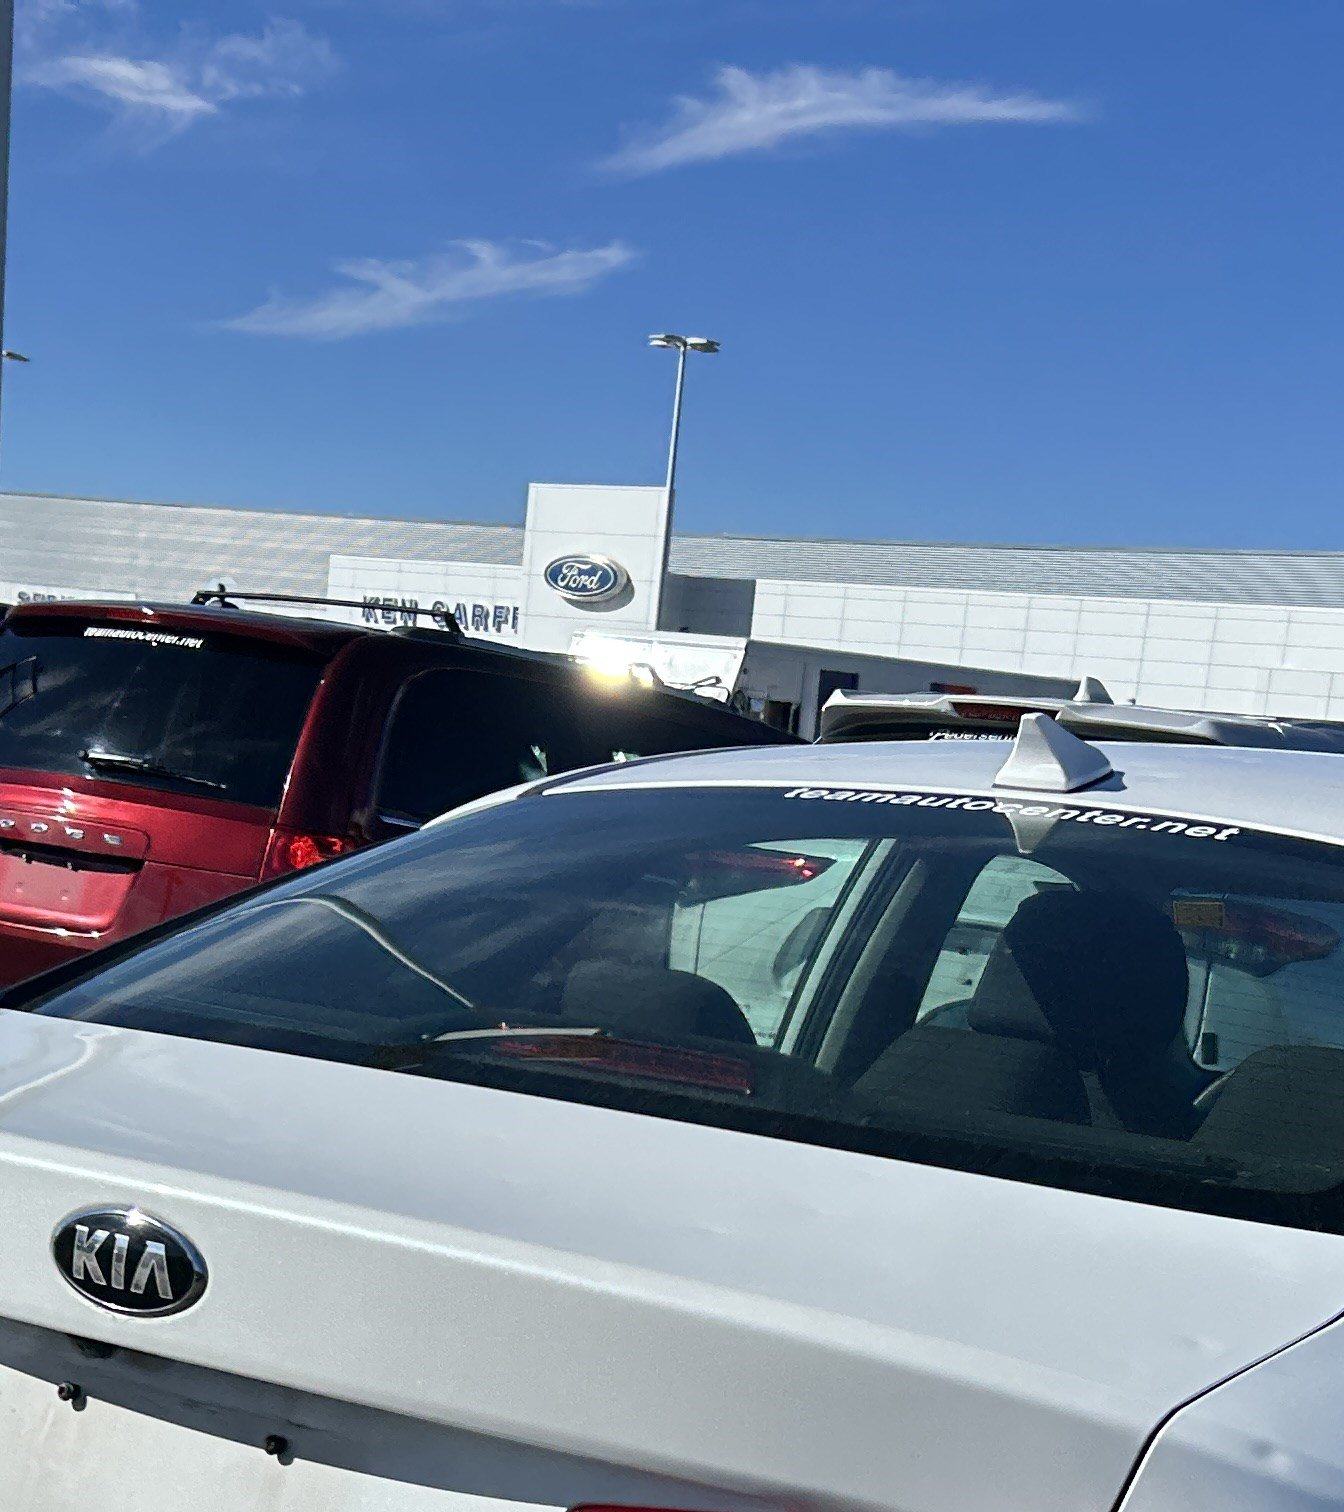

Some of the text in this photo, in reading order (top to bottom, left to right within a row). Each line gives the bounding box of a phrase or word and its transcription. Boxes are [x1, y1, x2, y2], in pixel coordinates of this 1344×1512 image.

[557, 562, 603, 590] Ford
[783, 786, 1241, 842] teamautocenter.net
[72, 1223, 174, 1300] KIA
